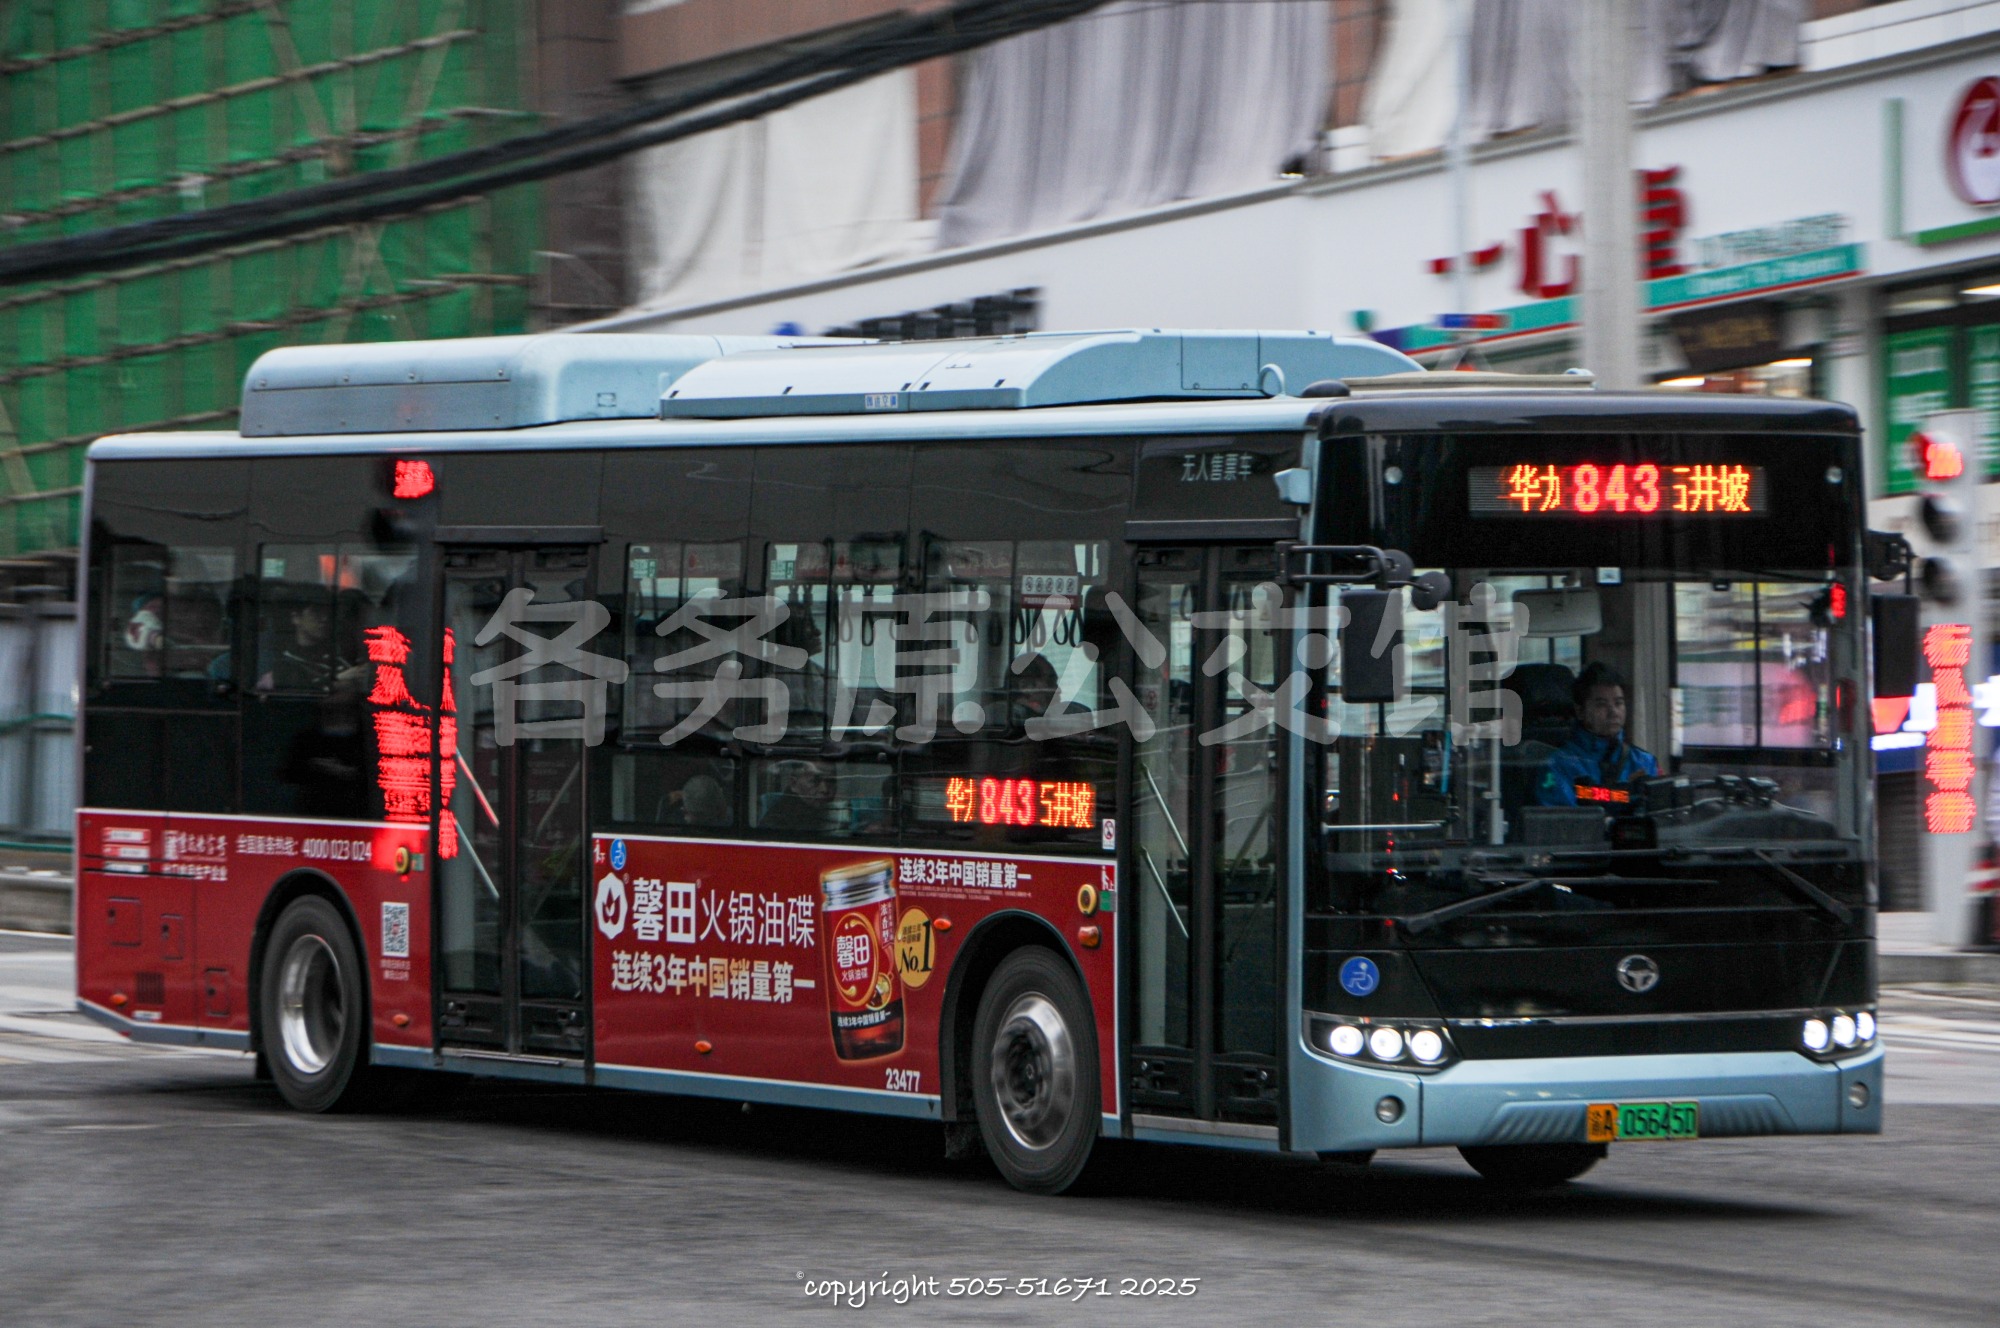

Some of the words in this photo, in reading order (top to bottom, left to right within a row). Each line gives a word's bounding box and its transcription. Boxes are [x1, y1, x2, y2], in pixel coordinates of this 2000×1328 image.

[1181, 452, 1253, 481] 无人售票车
[1573, 463, 1660, 513] 843
[979, 777, 1036, 826] 843
[330, 839, 350, 860] 023
[352, 841, 372, 861] 024
[899, 857, 1032, 889] 连续3年中国销量第一
[836, 934, 870, 969] 馨田
[611, 950, 815, 1004] 连续3年中国销量第一
[837, 1010, 892, 1027] 连续3年中国销量第一
[885, 1068, 920, 1092] 23477
